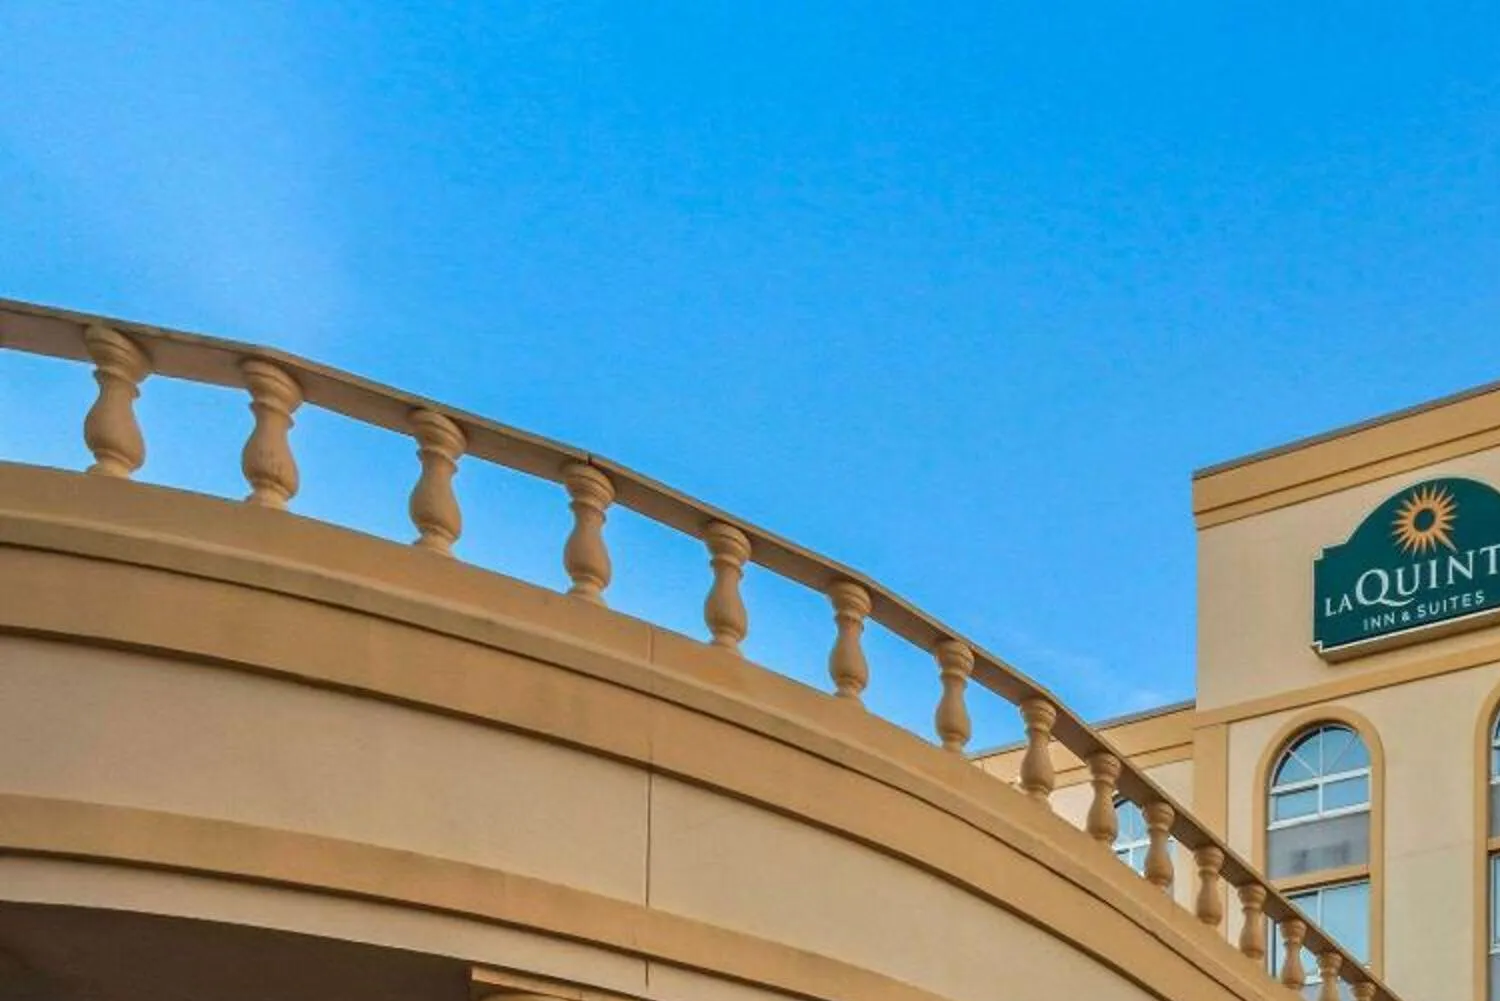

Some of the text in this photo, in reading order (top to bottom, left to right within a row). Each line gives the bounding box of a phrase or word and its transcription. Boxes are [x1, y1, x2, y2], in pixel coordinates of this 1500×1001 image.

[1325, 593, 1353, 617] LA
[1363, 589, 1485, 631] INN & SUITES
